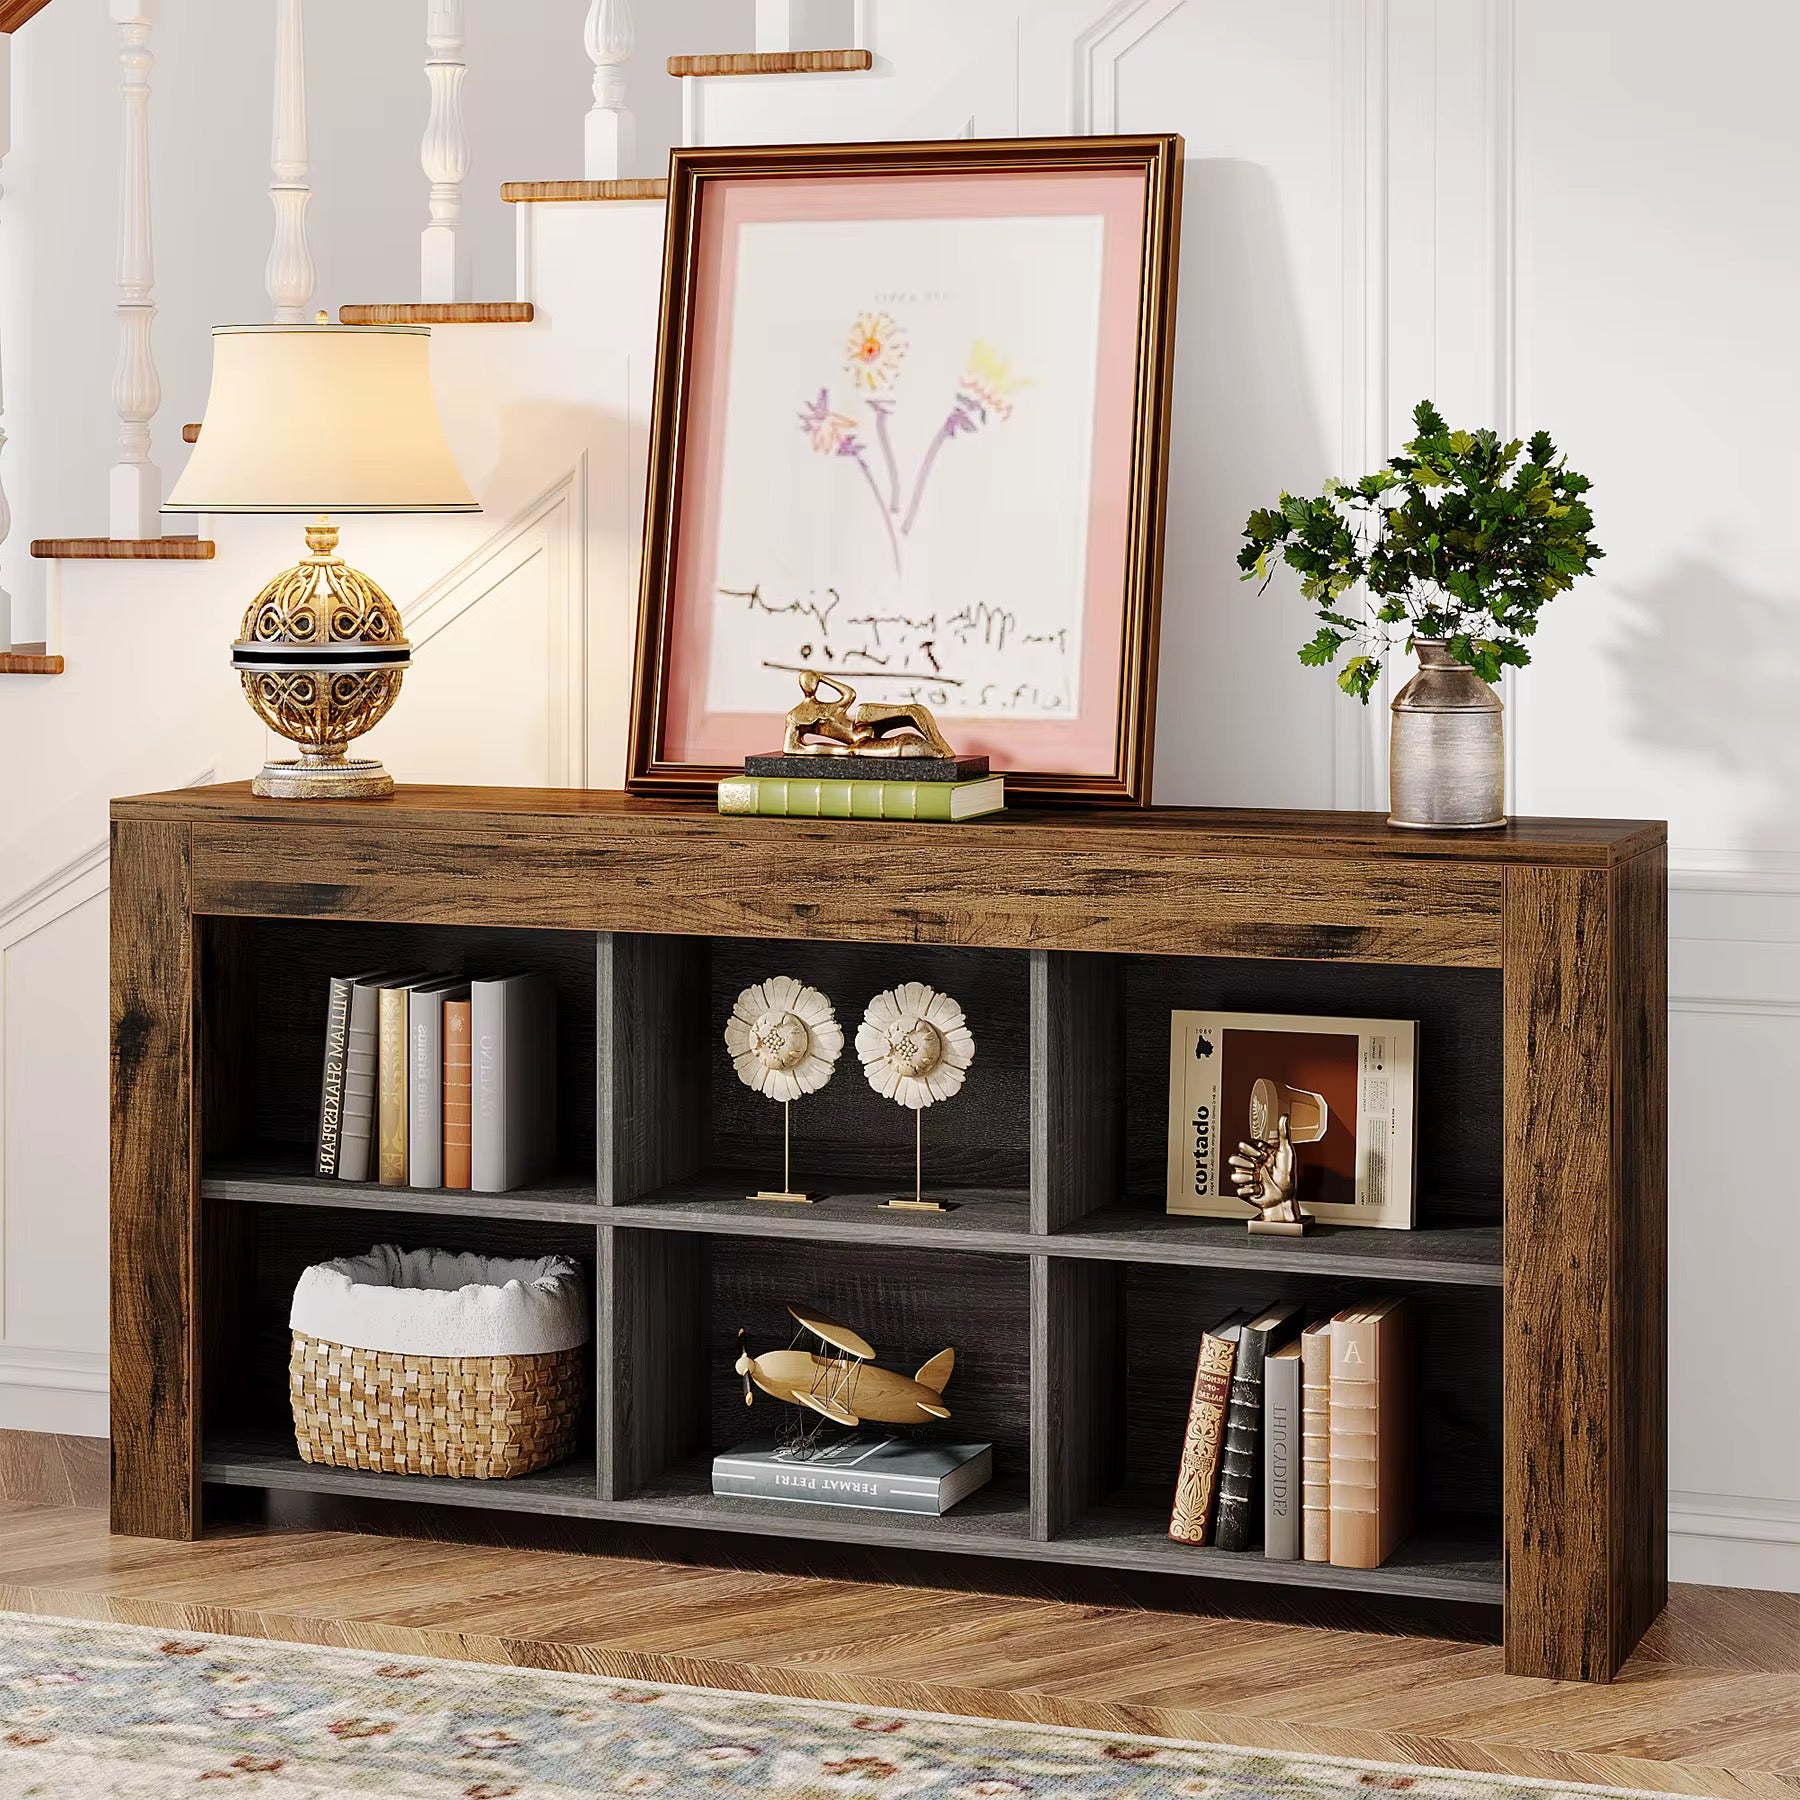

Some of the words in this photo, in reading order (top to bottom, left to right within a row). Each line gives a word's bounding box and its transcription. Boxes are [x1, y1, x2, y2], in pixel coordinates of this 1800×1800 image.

[1192, 1105, 1210, 1196] cortado
[1342, 1340, 1365, 1364] A
[775, 1474, 817, 1490] PETRI
[822, 1479, 878, 1496] FERMAT
